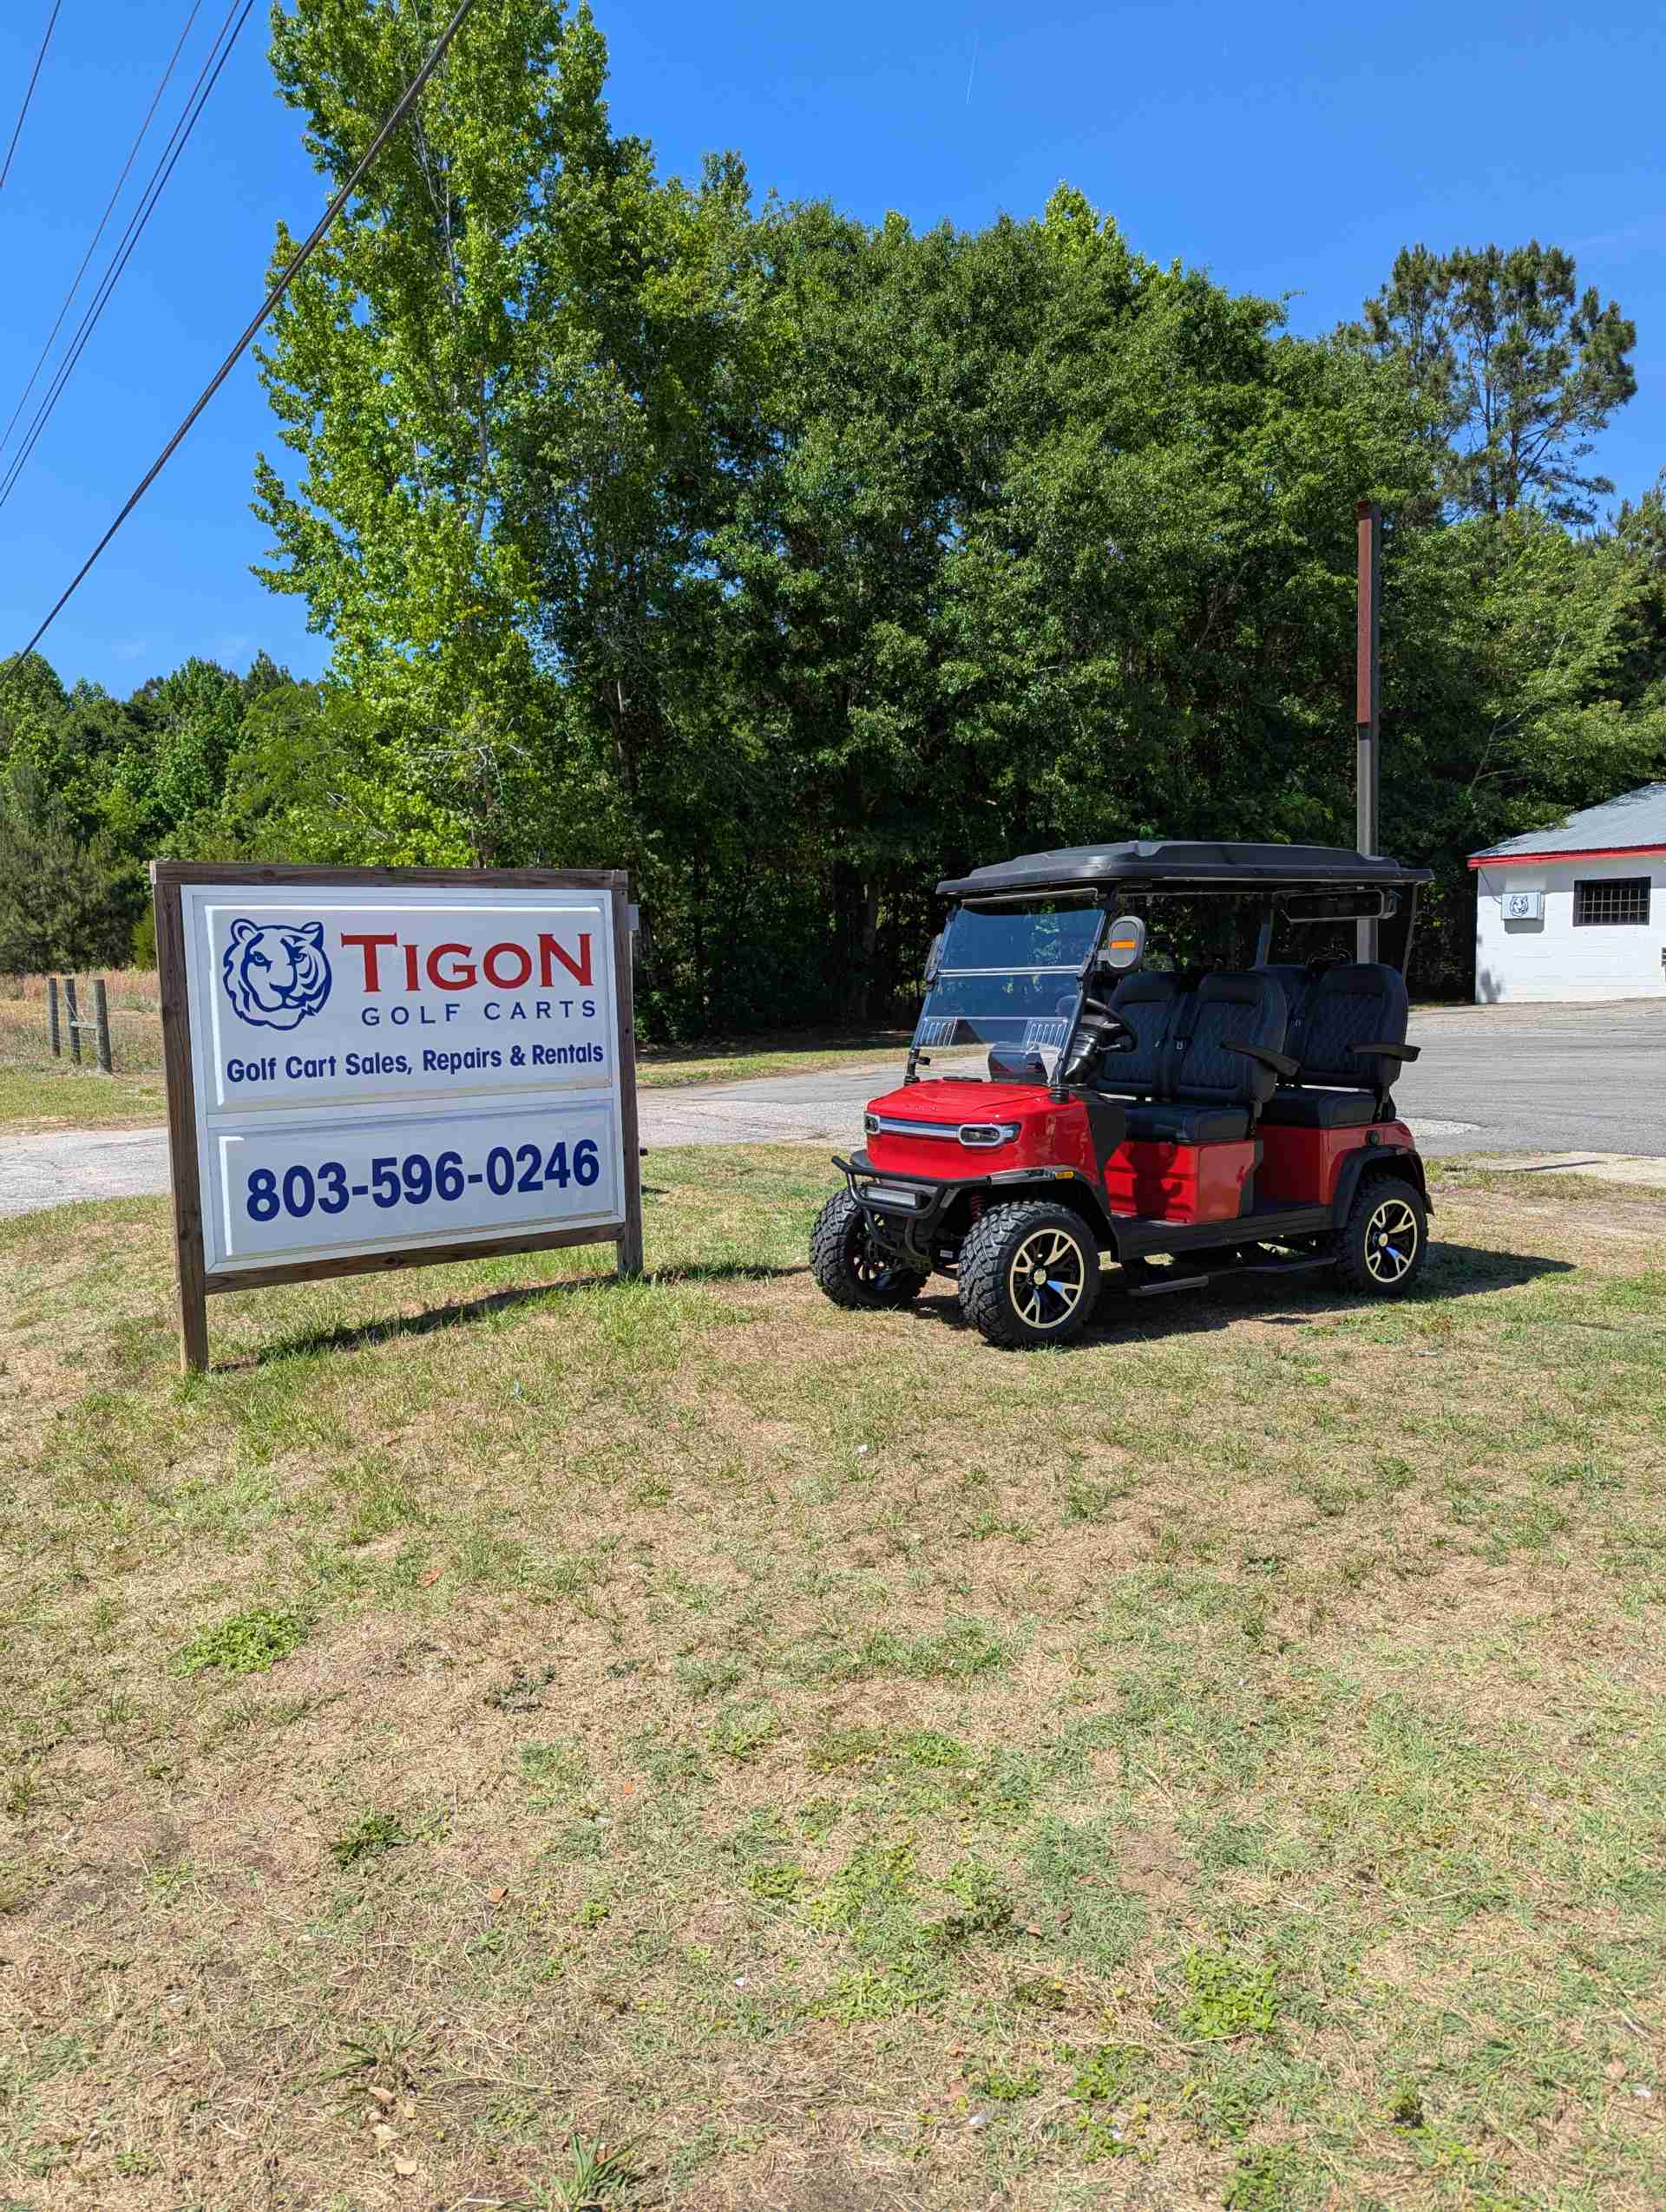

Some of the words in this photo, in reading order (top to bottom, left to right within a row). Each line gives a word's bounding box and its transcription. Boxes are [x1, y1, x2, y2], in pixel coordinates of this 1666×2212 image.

[341, 933, 594, 992] TIGON
[361, 1004, 460, 1026] GOLF
[484, 999, 596, 1021] CARTS
[226, 1057, 277, 1083] Golf
[285, 1055, 337, 1079] Cart
[345, 1051, 413, 1076] Sales,
[423, 1047, 502, 1076] Repairs
[509, 1044, 527, 1067] &
[532, 1042, 604, 1066] Rentals
[246, 1139, 600, 1222] 803-596-0246
